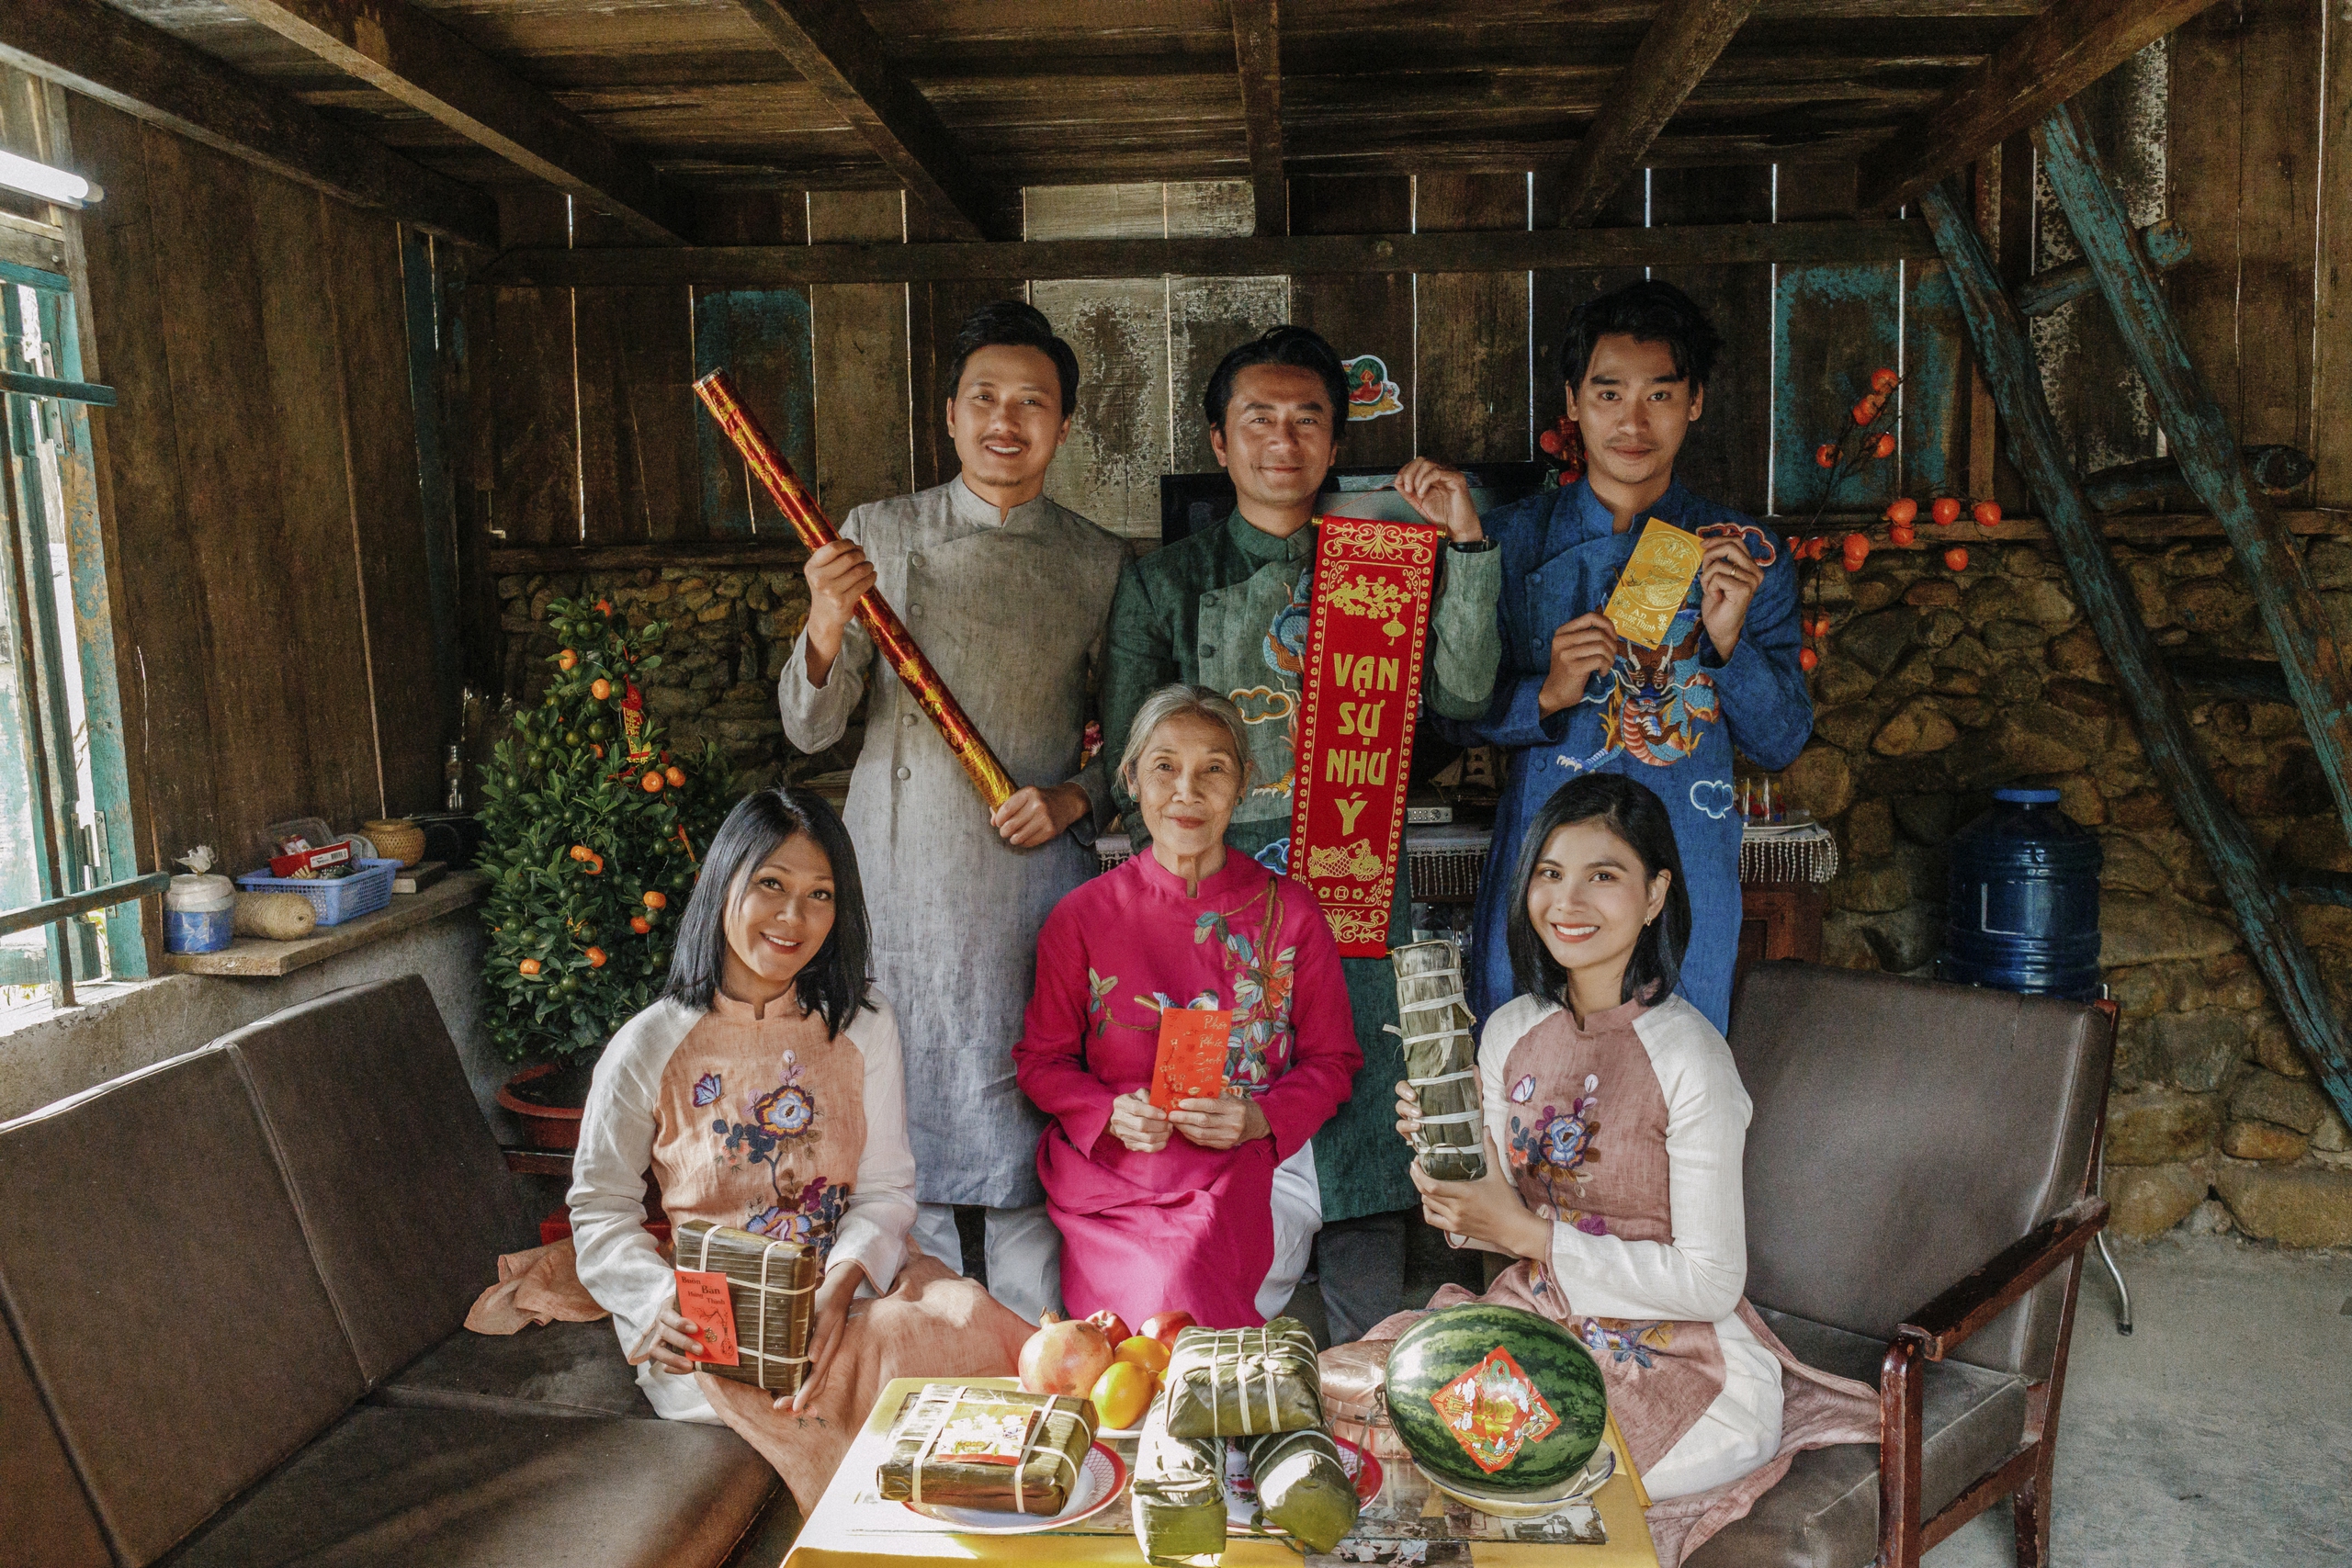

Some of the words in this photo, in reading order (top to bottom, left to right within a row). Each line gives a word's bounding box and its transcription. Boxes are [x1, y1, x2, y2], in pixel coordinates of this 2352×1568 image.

[1615, 608, 1637, 625] Khang
[1631, 608, 1647, 620] An
[1333, 652, 1400, 697] VẠN
[1338, 699, 1385, 745] SỰ
[1325, 748, 1392, 788] NHƯ
[1334, 792, 1368, 837] Ý
